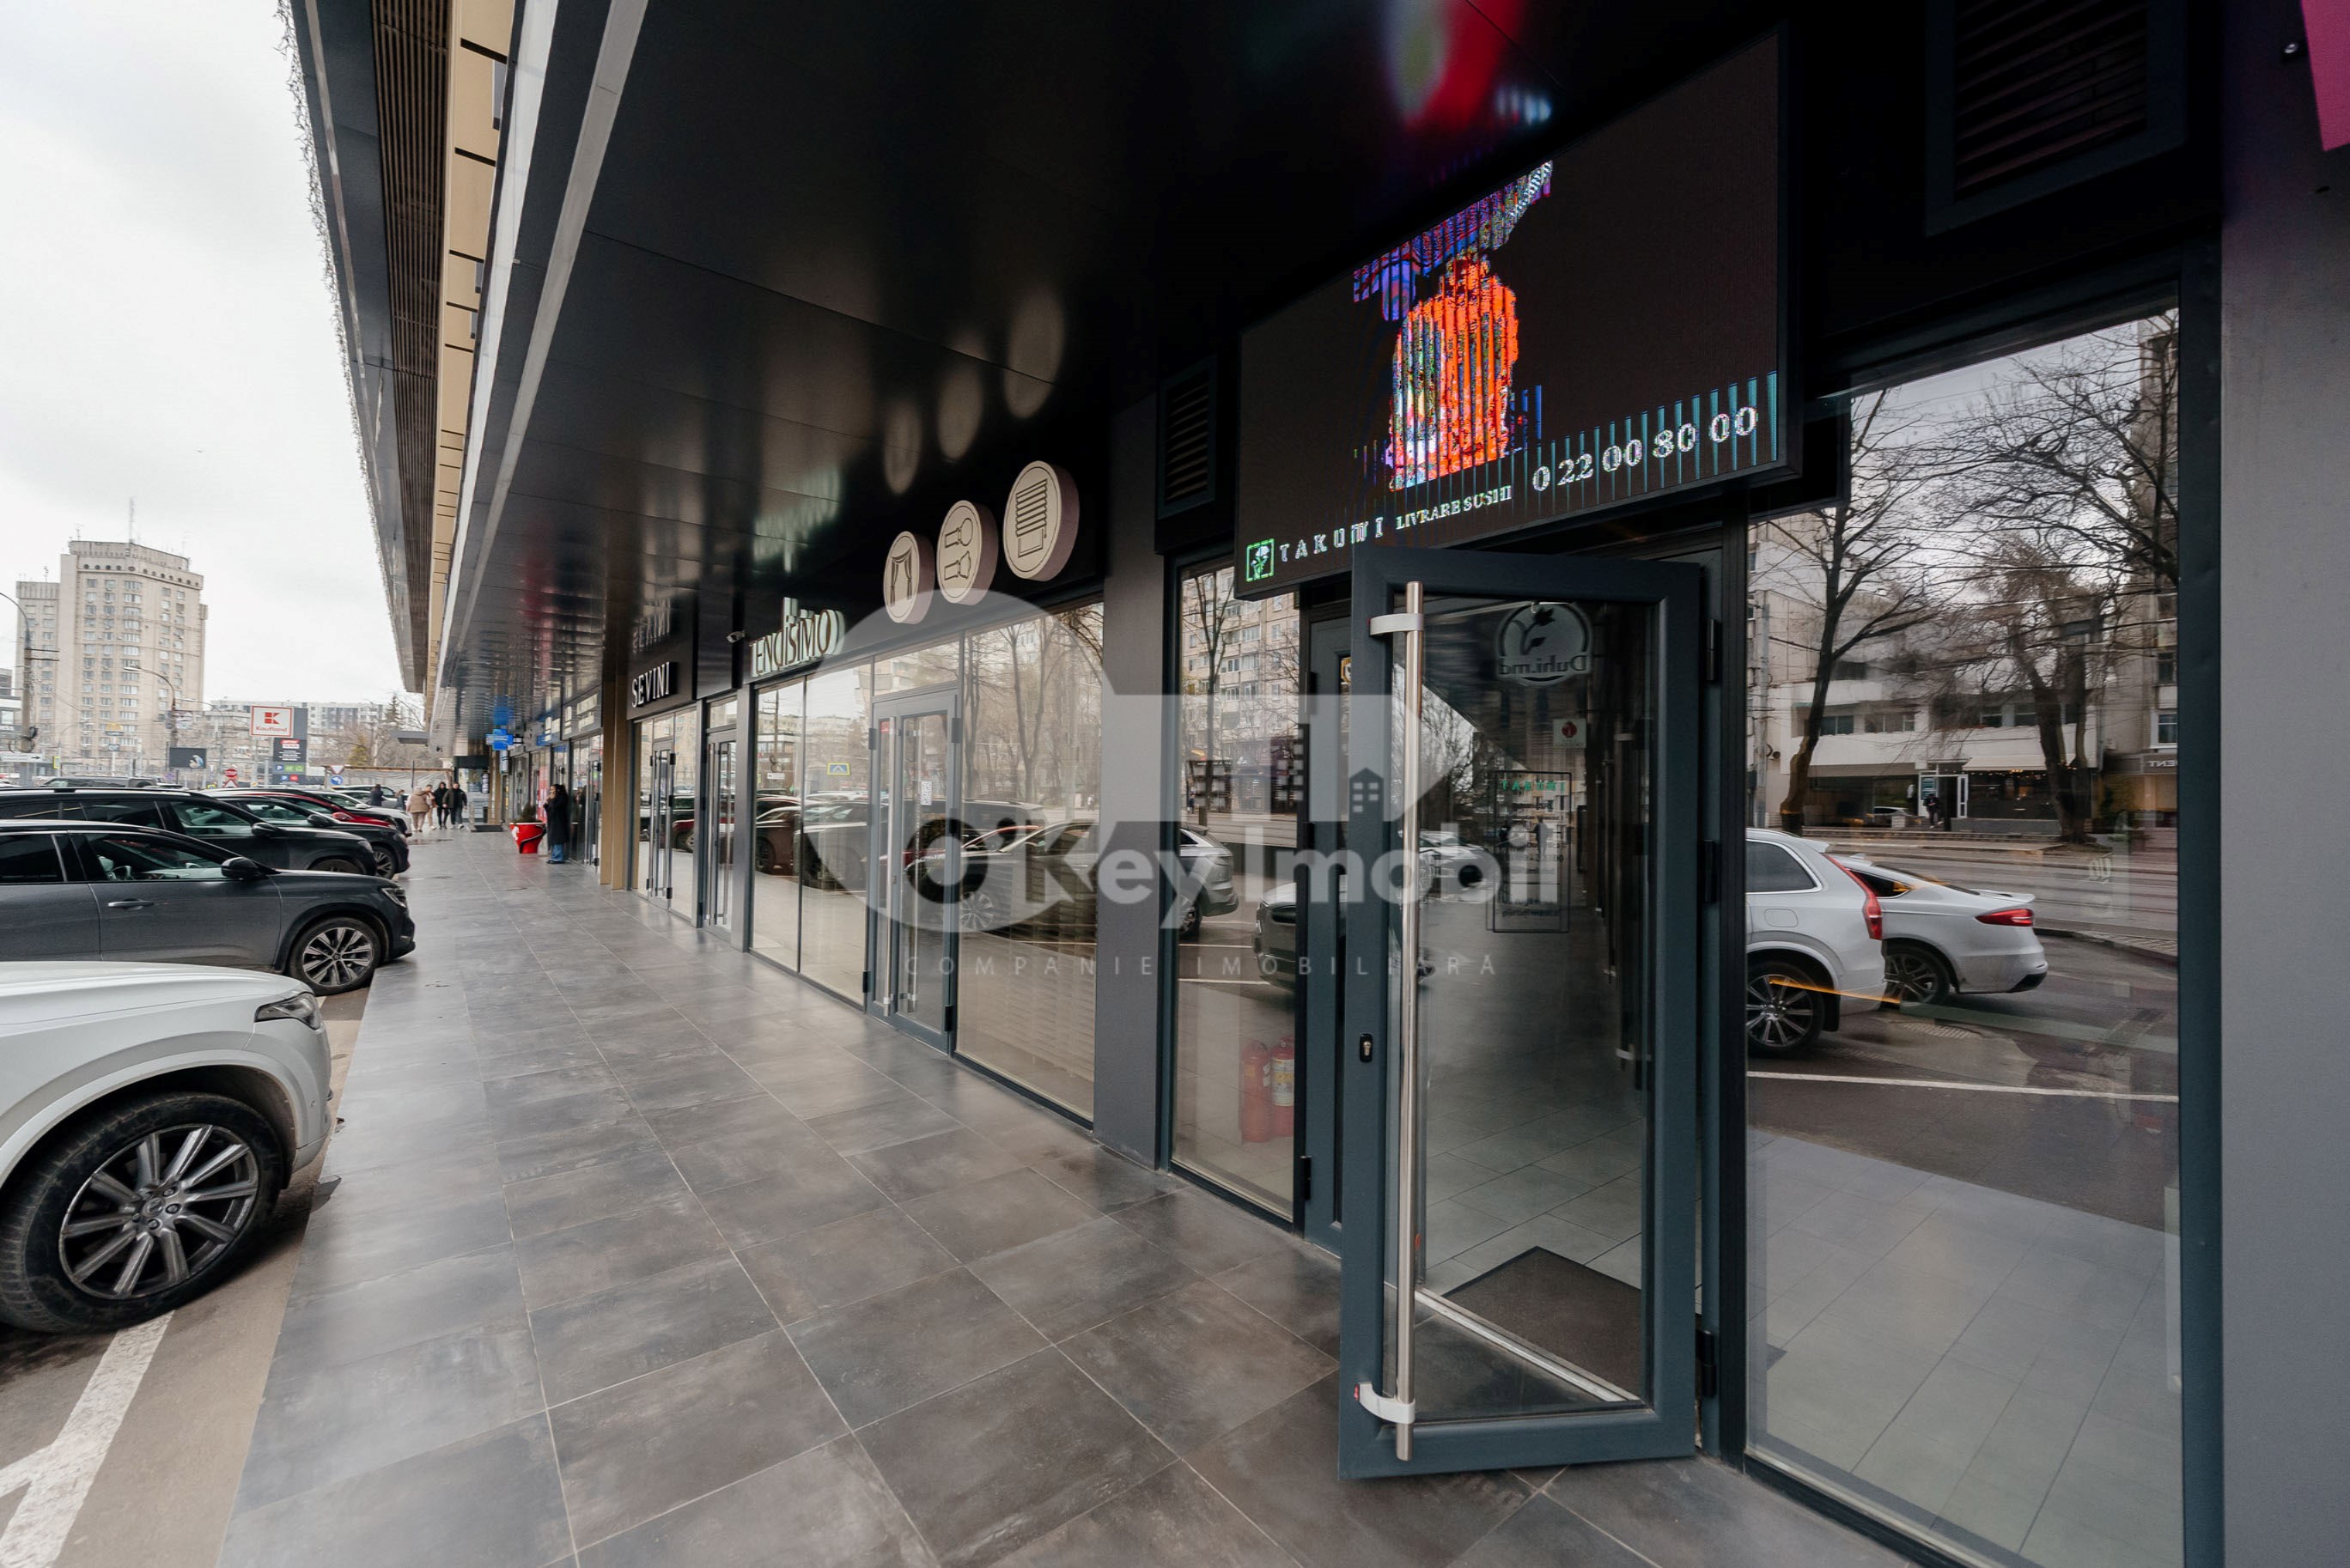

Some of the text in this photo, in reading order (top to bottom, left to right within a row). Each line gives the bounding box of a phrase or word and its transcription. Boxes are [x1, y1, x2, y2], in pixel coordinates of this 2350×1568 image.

[1532, 406, 1757, 492] 0 22 00 80 00
[1395, 484, 1512, 530] LIVRARE SUSHI
[1279, 516, 1384, 562] TAKUMI
[631, 661, 670, 708] SEVINI
